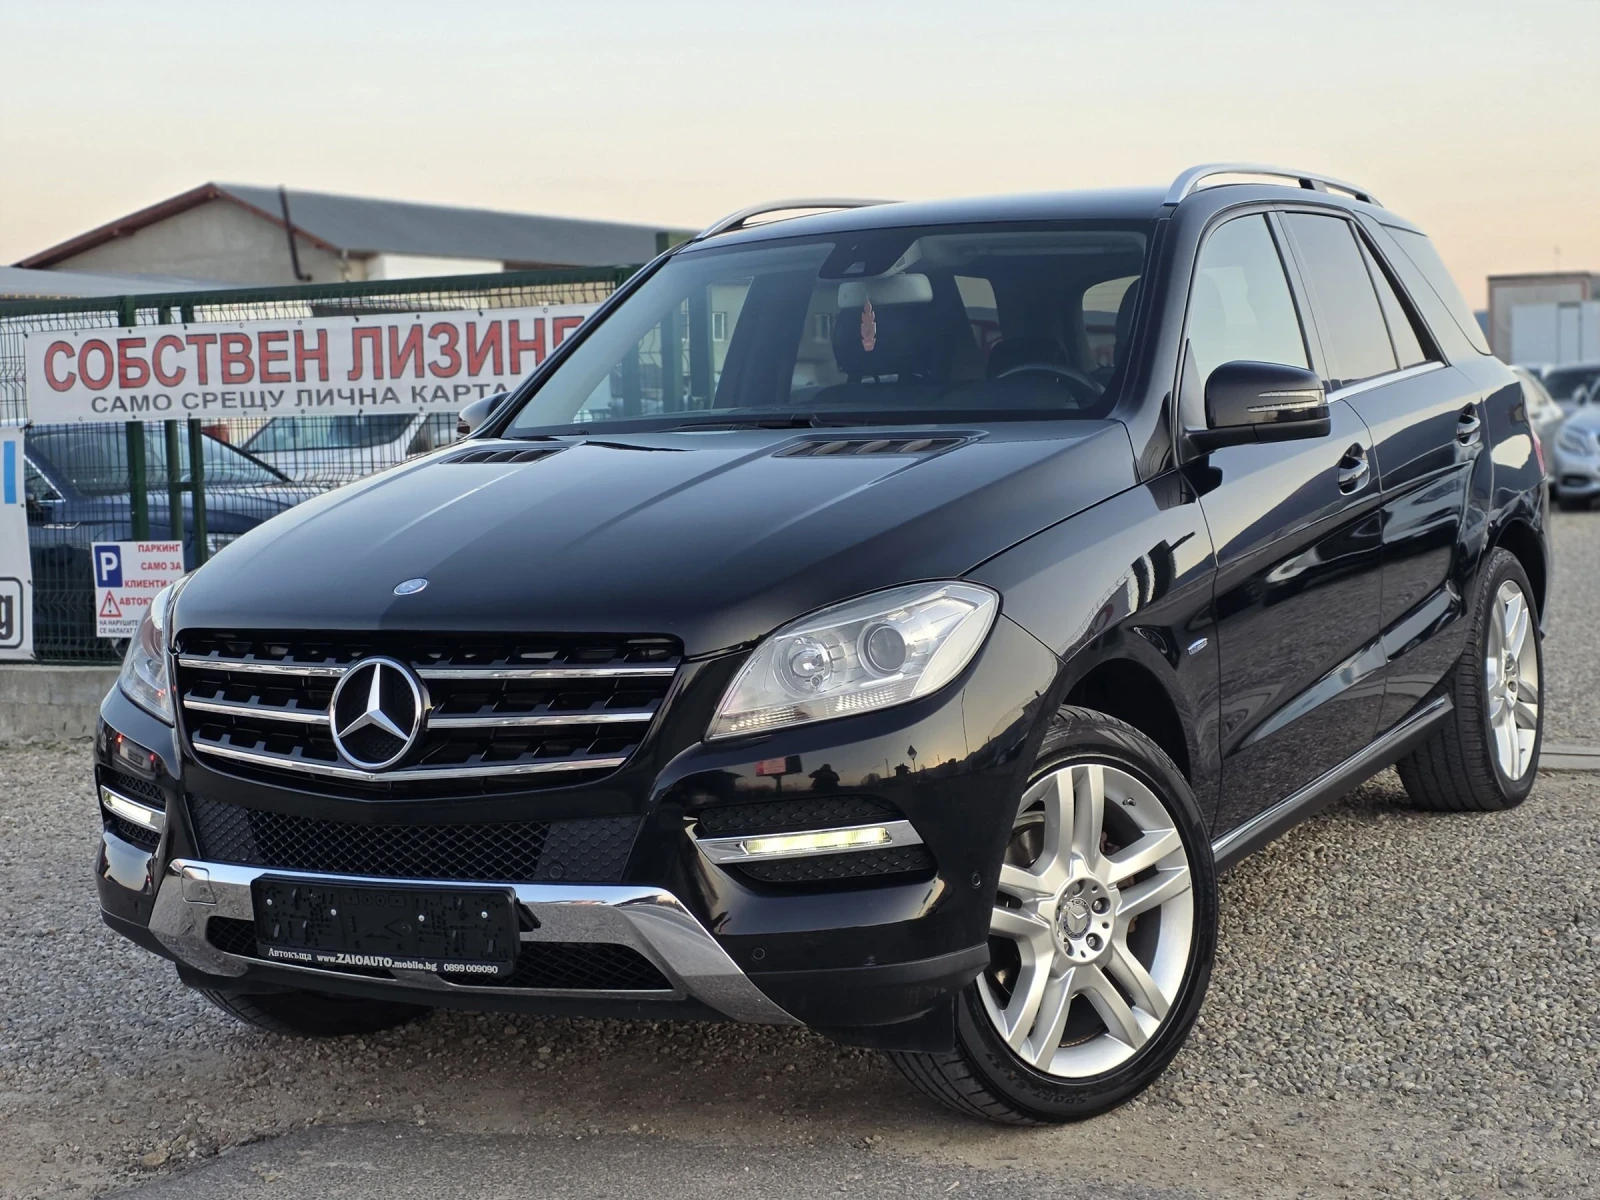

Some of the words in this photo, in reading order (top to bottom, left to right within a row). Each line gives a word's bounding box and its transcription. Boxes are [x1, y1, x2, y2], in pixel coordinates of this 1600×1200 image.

[43, 328, 330, 393] СОБСТВЕН
[91, 394, 173, 413] САМО
[181, 389, 285, 411] СРЕЩУ
[294, 386, 401, 407] ЛИЧНА
[138, 544, 180, 553] ПАРКИНГ
[141, 562, 167, 571] САМО
[170, 561, 182, 571] ЗА
[124, 580, 167, 589] КЛИЕНТИ
[268, 948, 312, 962] Автокъща
